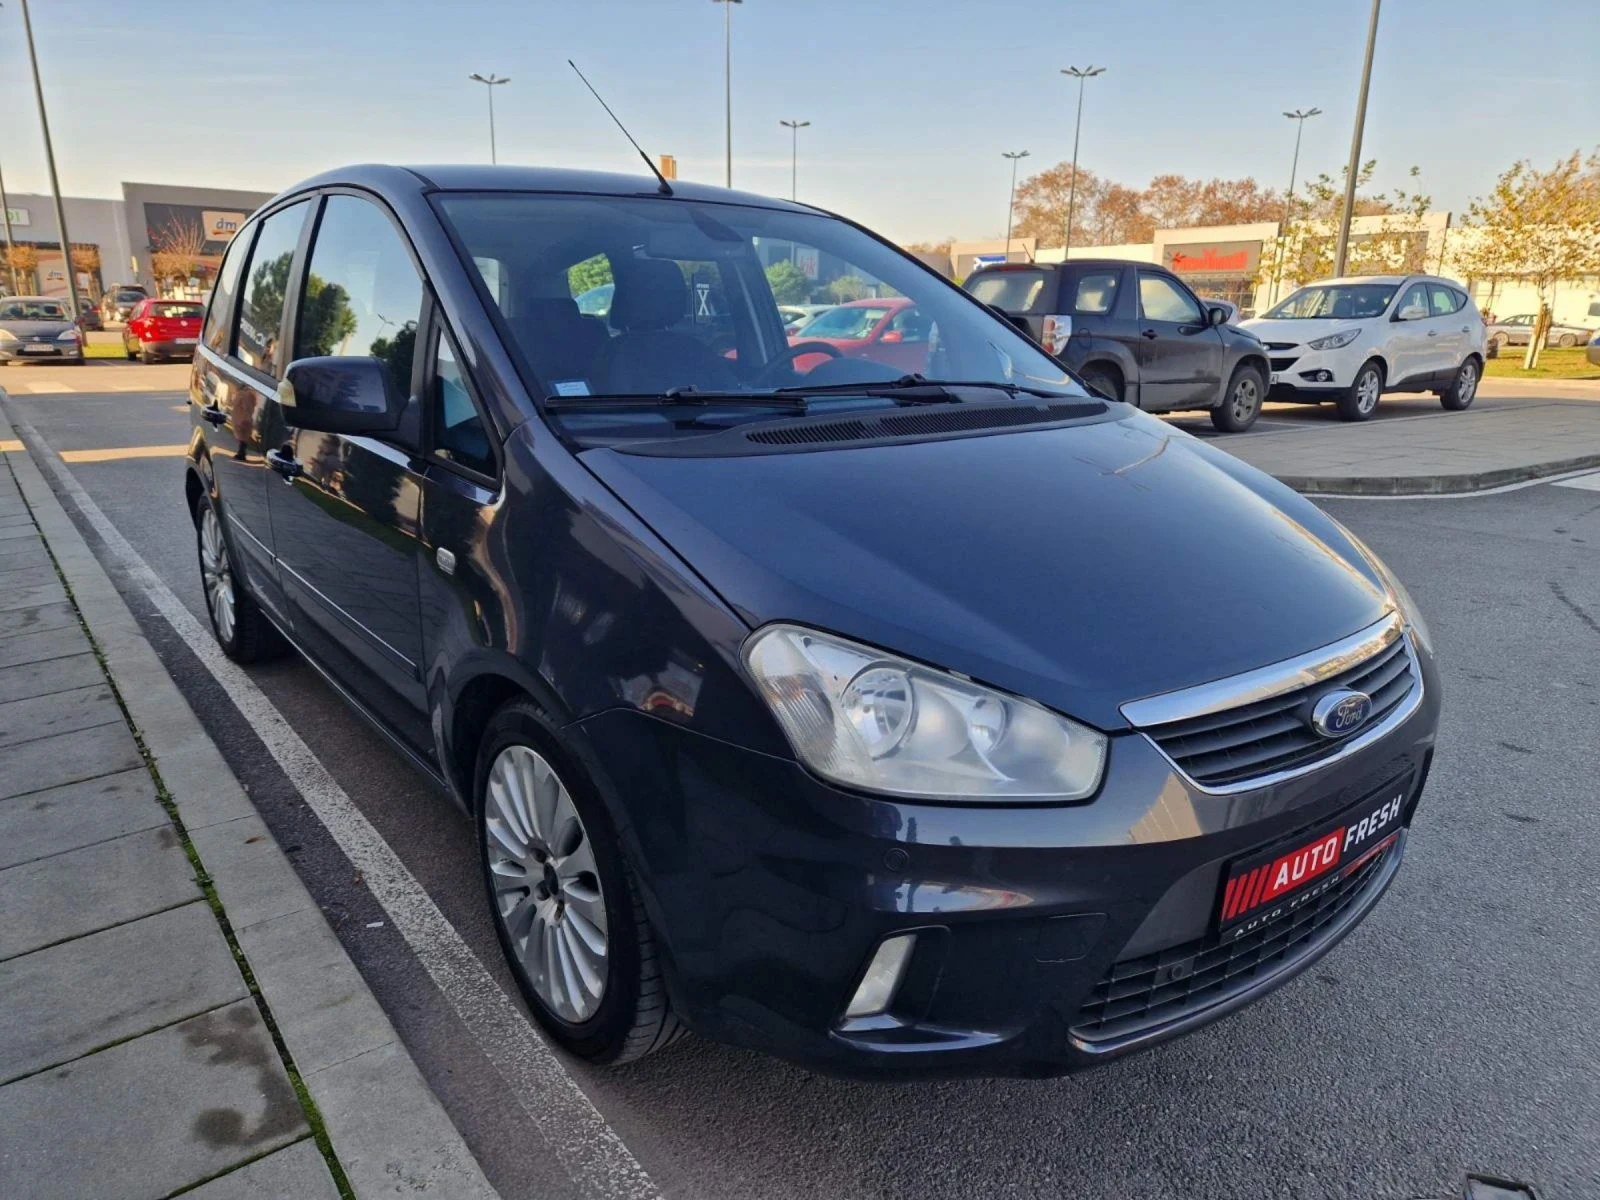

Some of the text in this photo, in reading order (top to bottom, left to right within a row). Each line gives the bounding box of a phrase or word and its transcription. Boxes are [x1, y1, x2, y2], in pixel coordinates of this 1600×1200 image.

[216, 217, 237, 230] dm
[1336, 703, 1363, 728] Ford
[1273, 836, 1338, 891] AUTO
[1343, 794, 1402, 853] FRESH
[1234, 876, 1339, 937] AUTO FRESH
